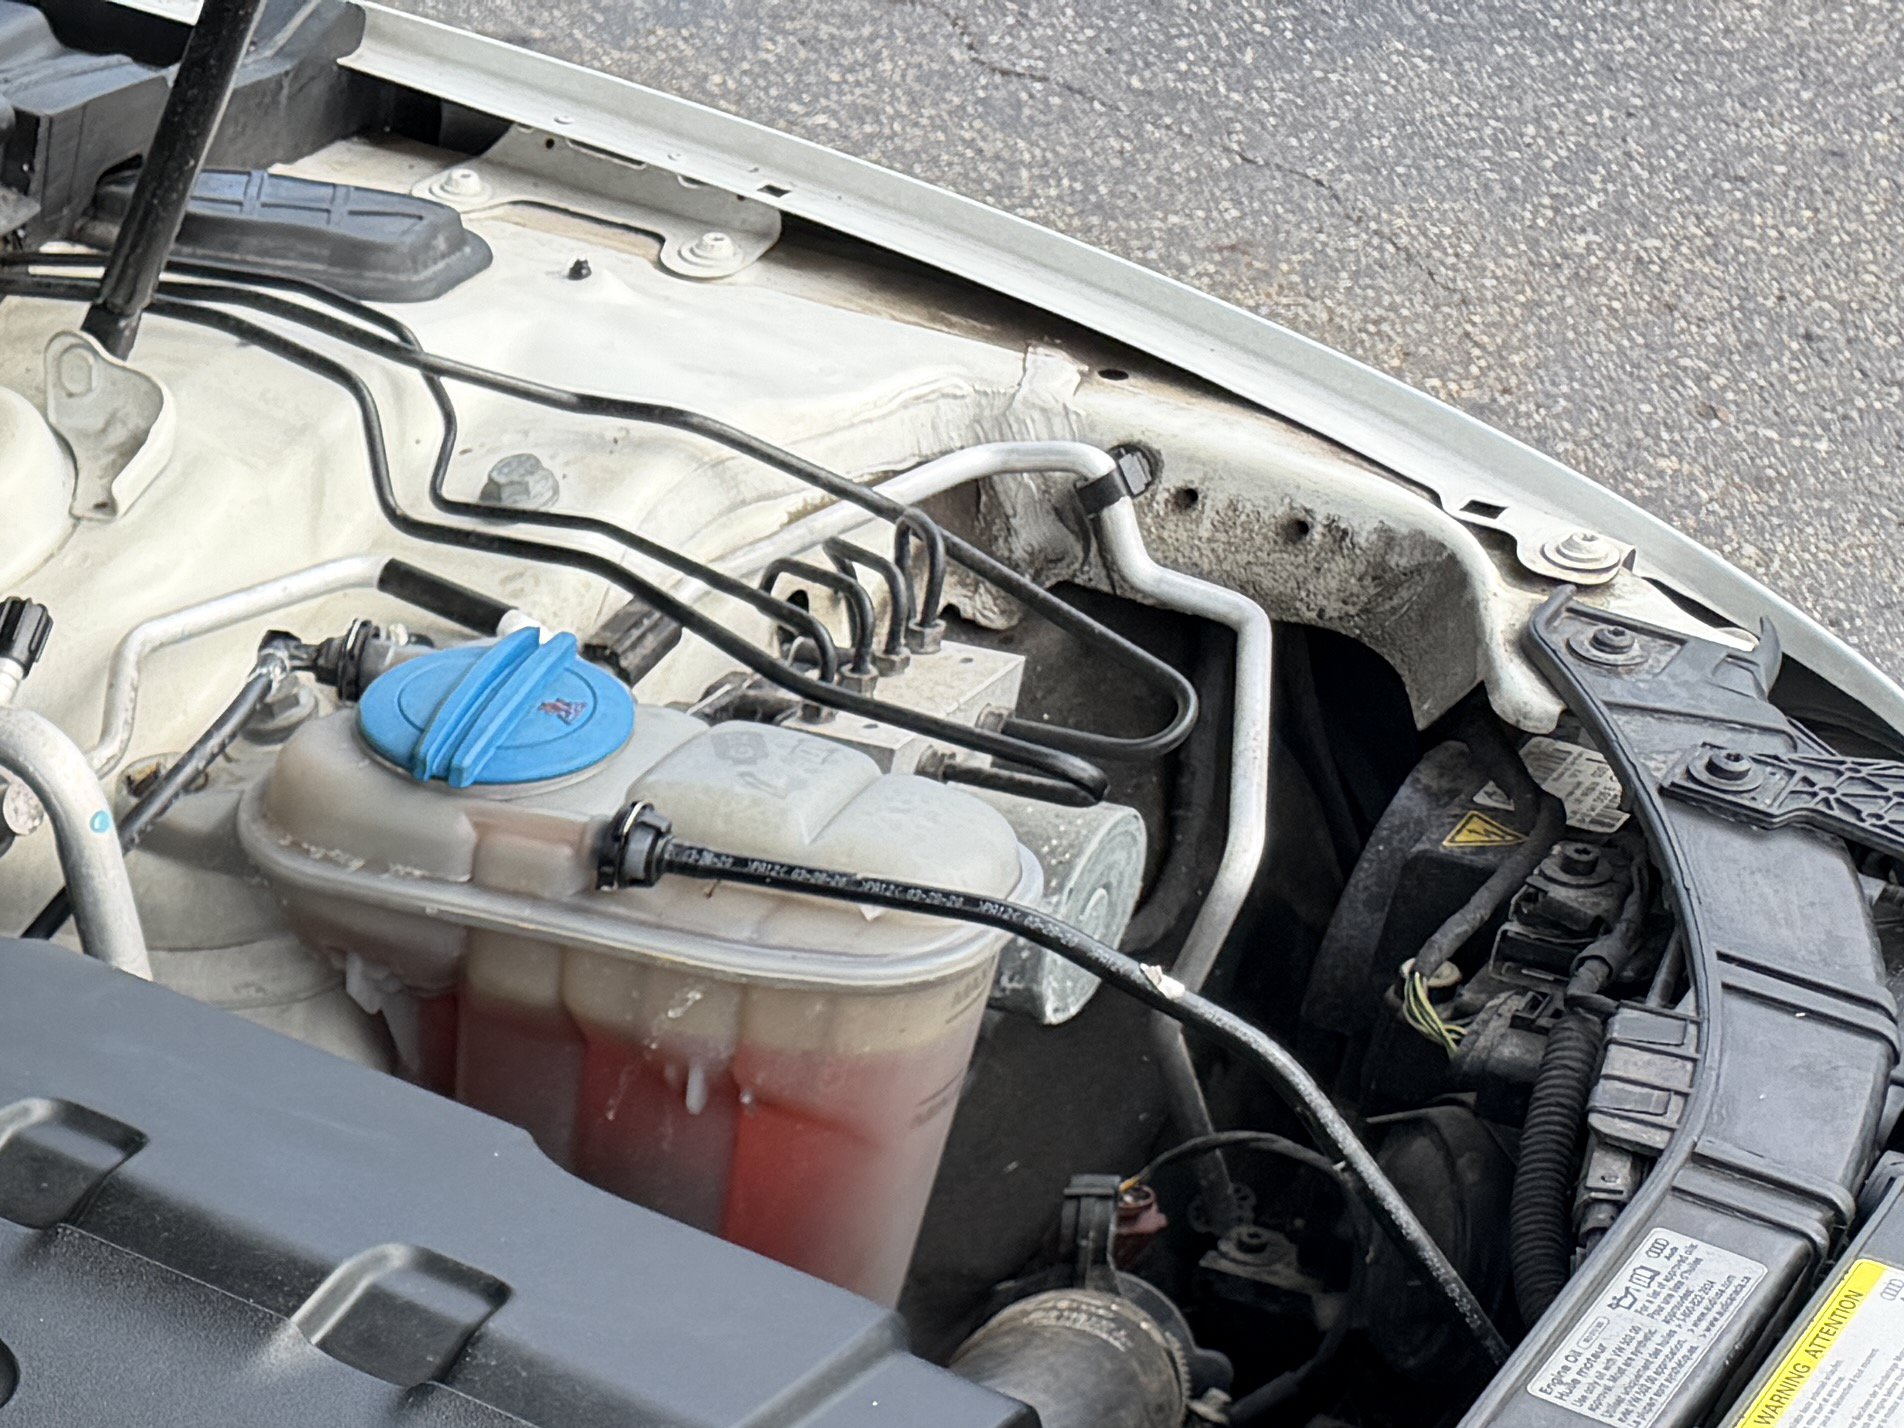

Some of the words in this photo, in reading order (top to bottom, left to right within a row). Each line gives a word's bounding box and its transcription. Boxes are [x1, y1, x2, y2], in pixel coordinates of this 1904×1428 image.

[1807, 1288, 1865, 1361] ATTENTION
[1538, 1363, 1574, 1396] Engine
[1562, 1348, 1583, 1364] Oil
[1555, 1376, 1582, 1402] Huile
[1574, 1342, 1609, 1377] moteur
